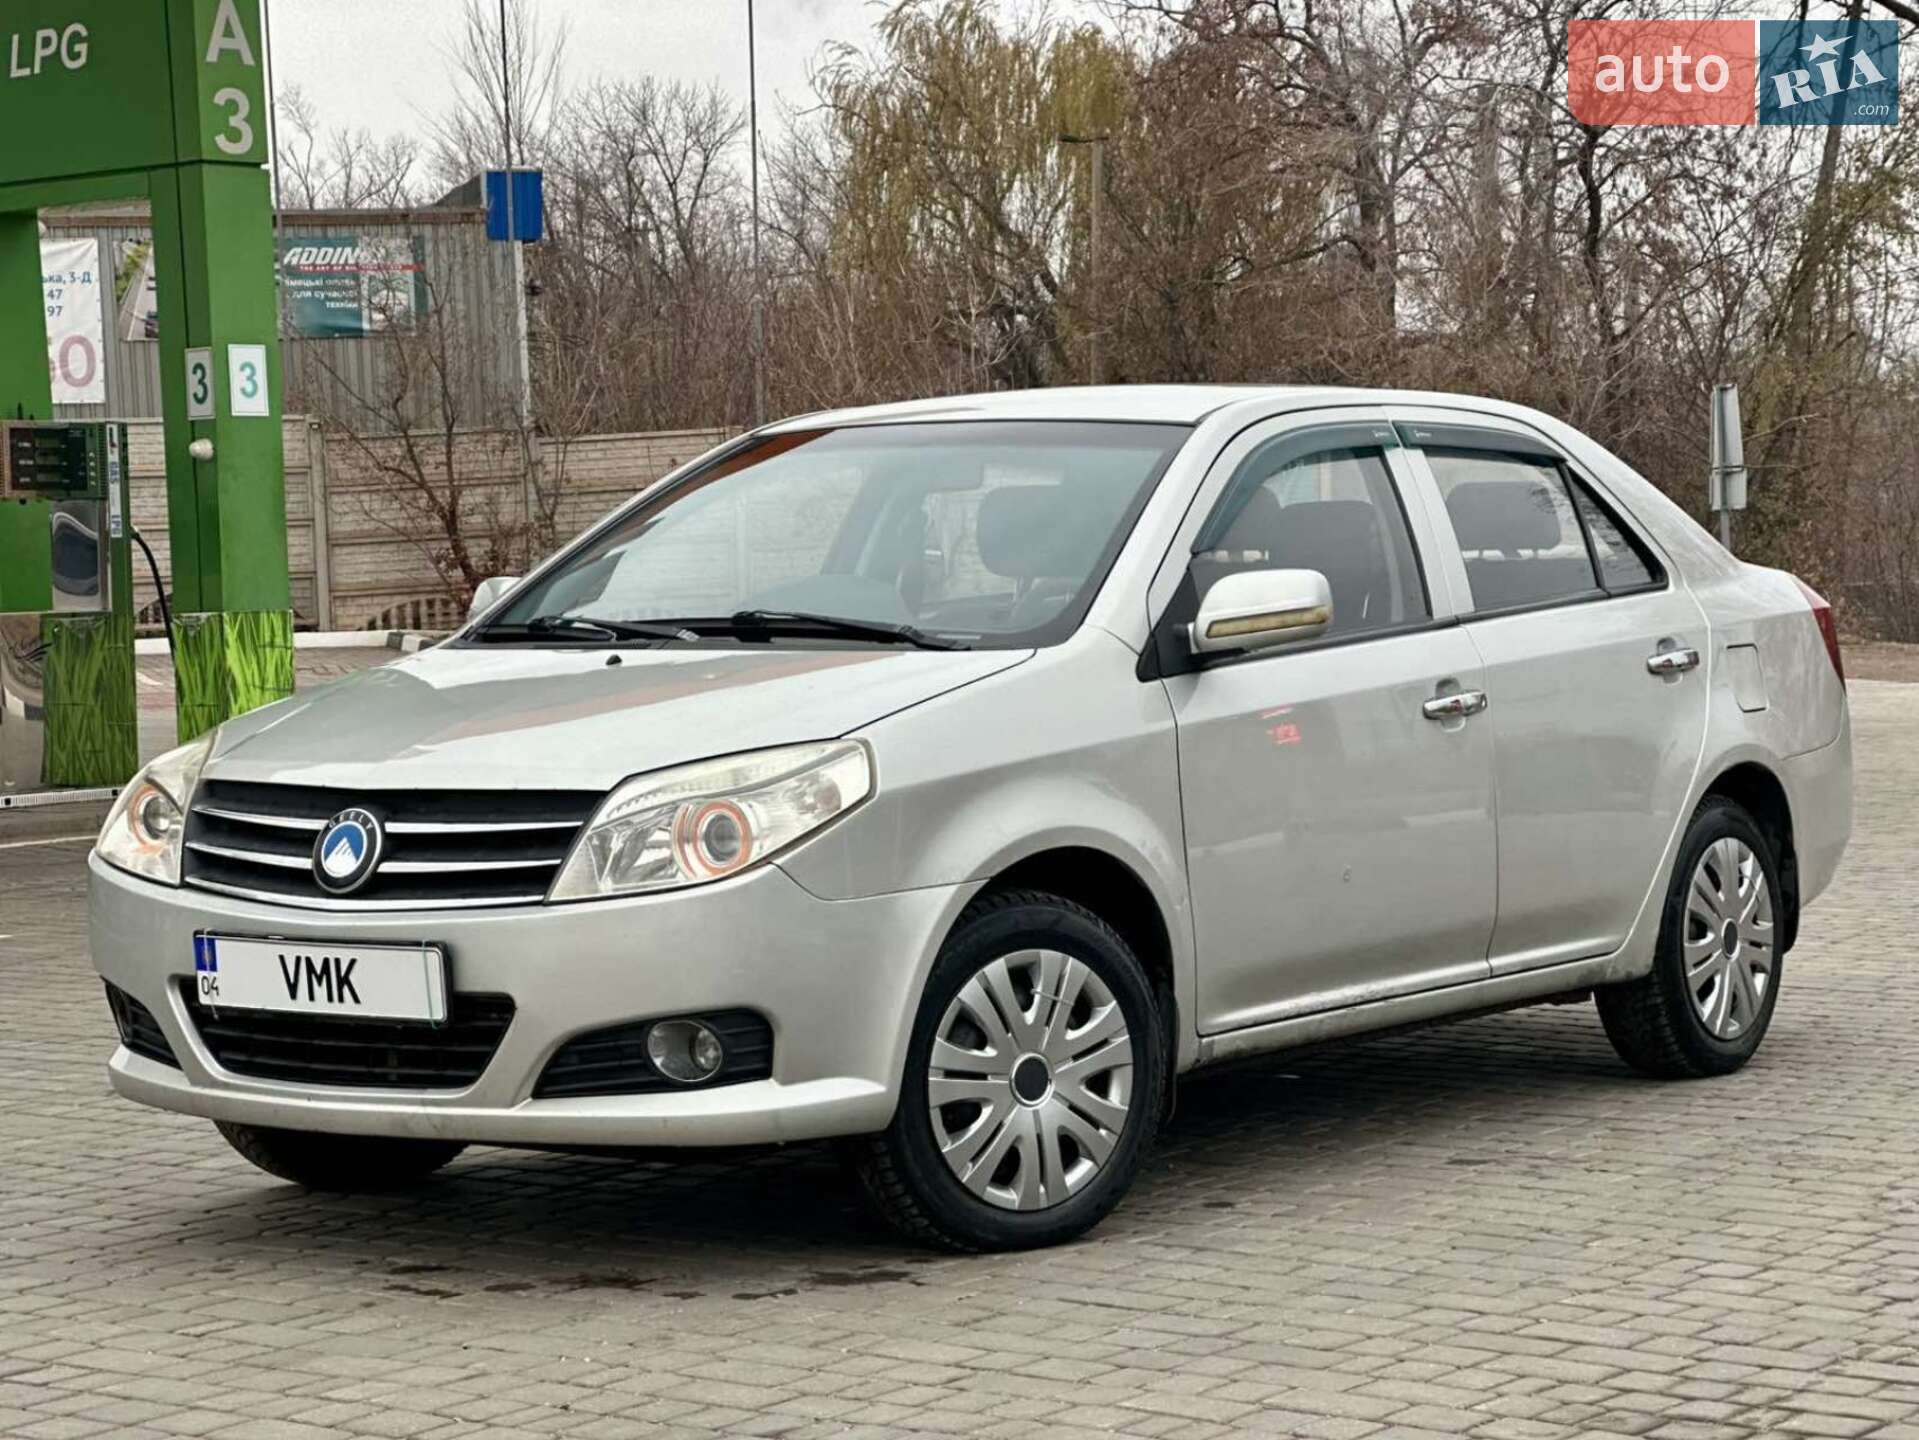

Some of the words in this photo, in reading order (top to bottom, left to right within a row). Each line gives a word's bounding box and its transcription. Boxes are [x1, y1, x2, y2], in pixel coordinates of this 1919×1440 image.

[10, 22, 89, 79] LPG
[205, 0, 256, 67] A
[213, 87, 254, 155] 3
[47, 288, 63, 301] 47
[47, 305, 63, 318] 97
[192, 362, 209, 405] 3
[240, 361, 258, 399] 3
[200, 975, 220, 997] 04
[277, 953, 362, 1005] VMK
